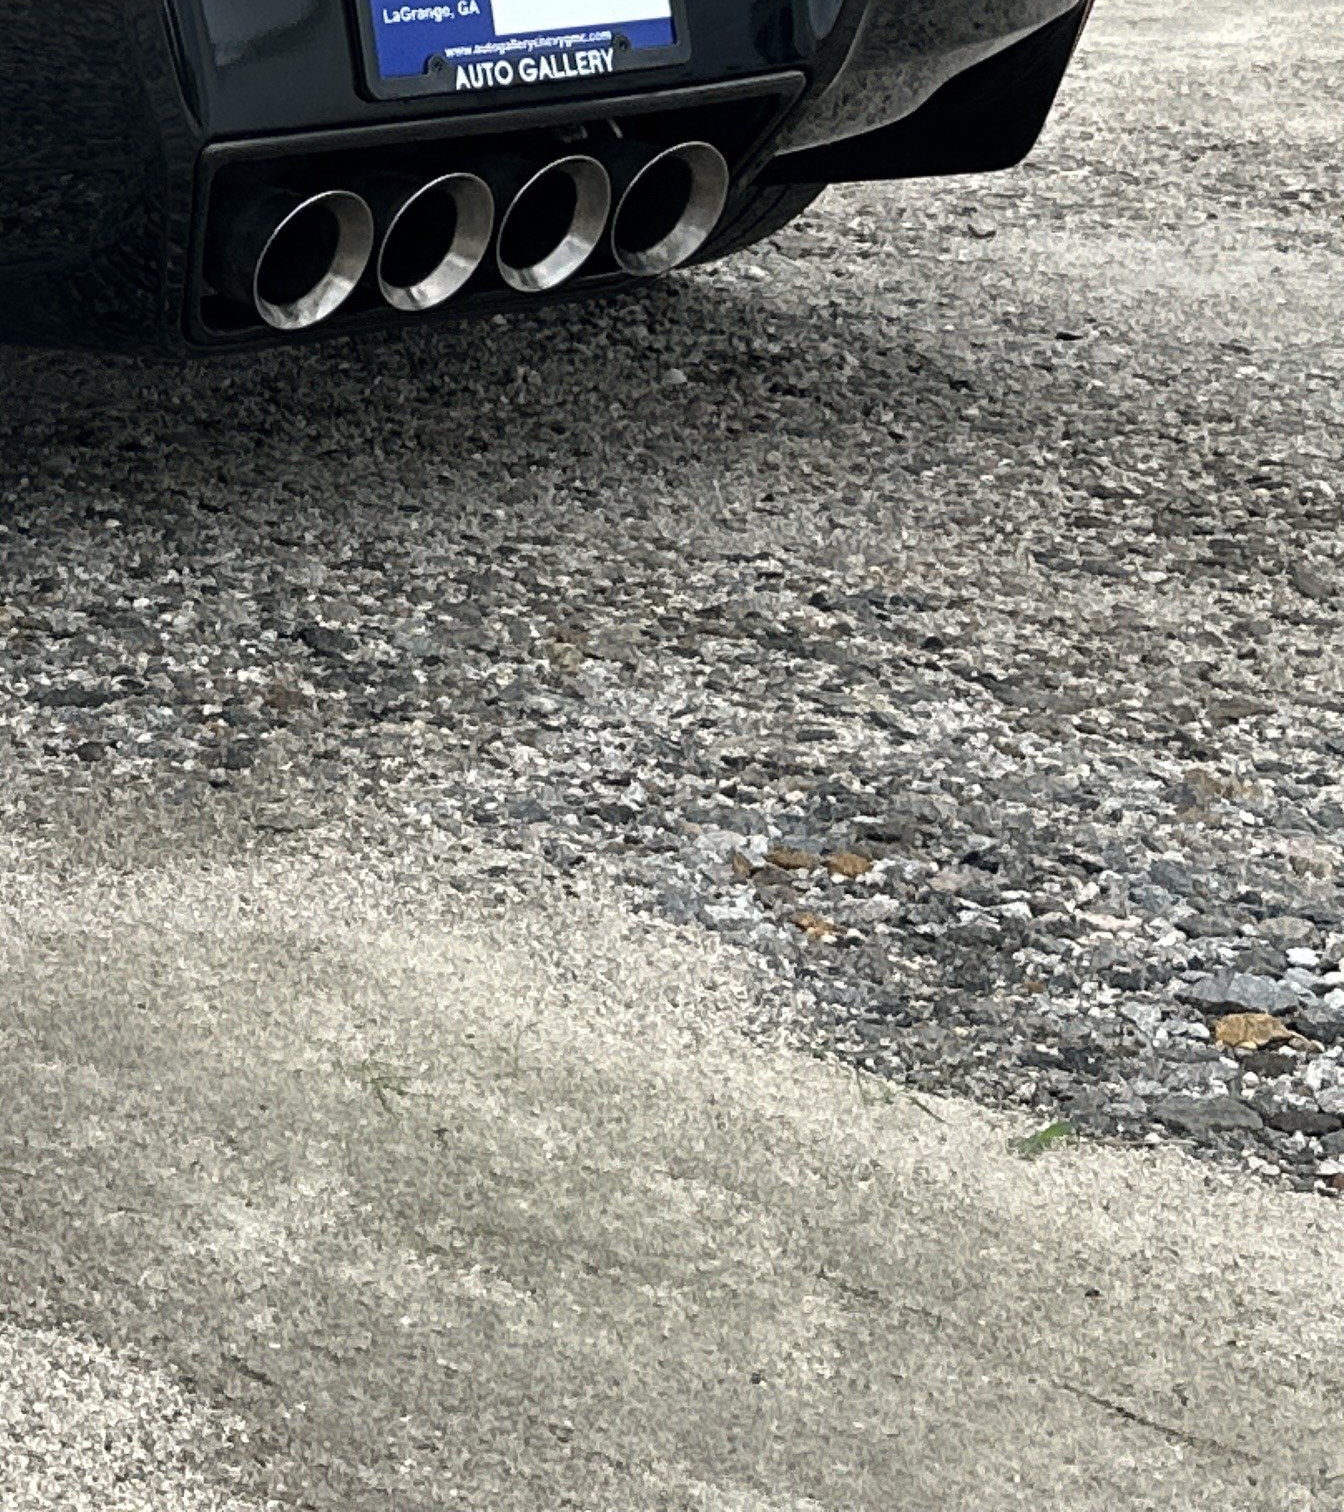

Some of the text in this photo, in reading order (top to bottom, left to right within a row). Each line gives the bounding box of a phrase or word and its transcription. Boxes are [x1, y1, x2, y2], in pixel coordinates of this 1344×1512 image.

[382, 0, 481, 24] LaGrange, GA
[456, 47, 613, 90] AUTO GALLERY
